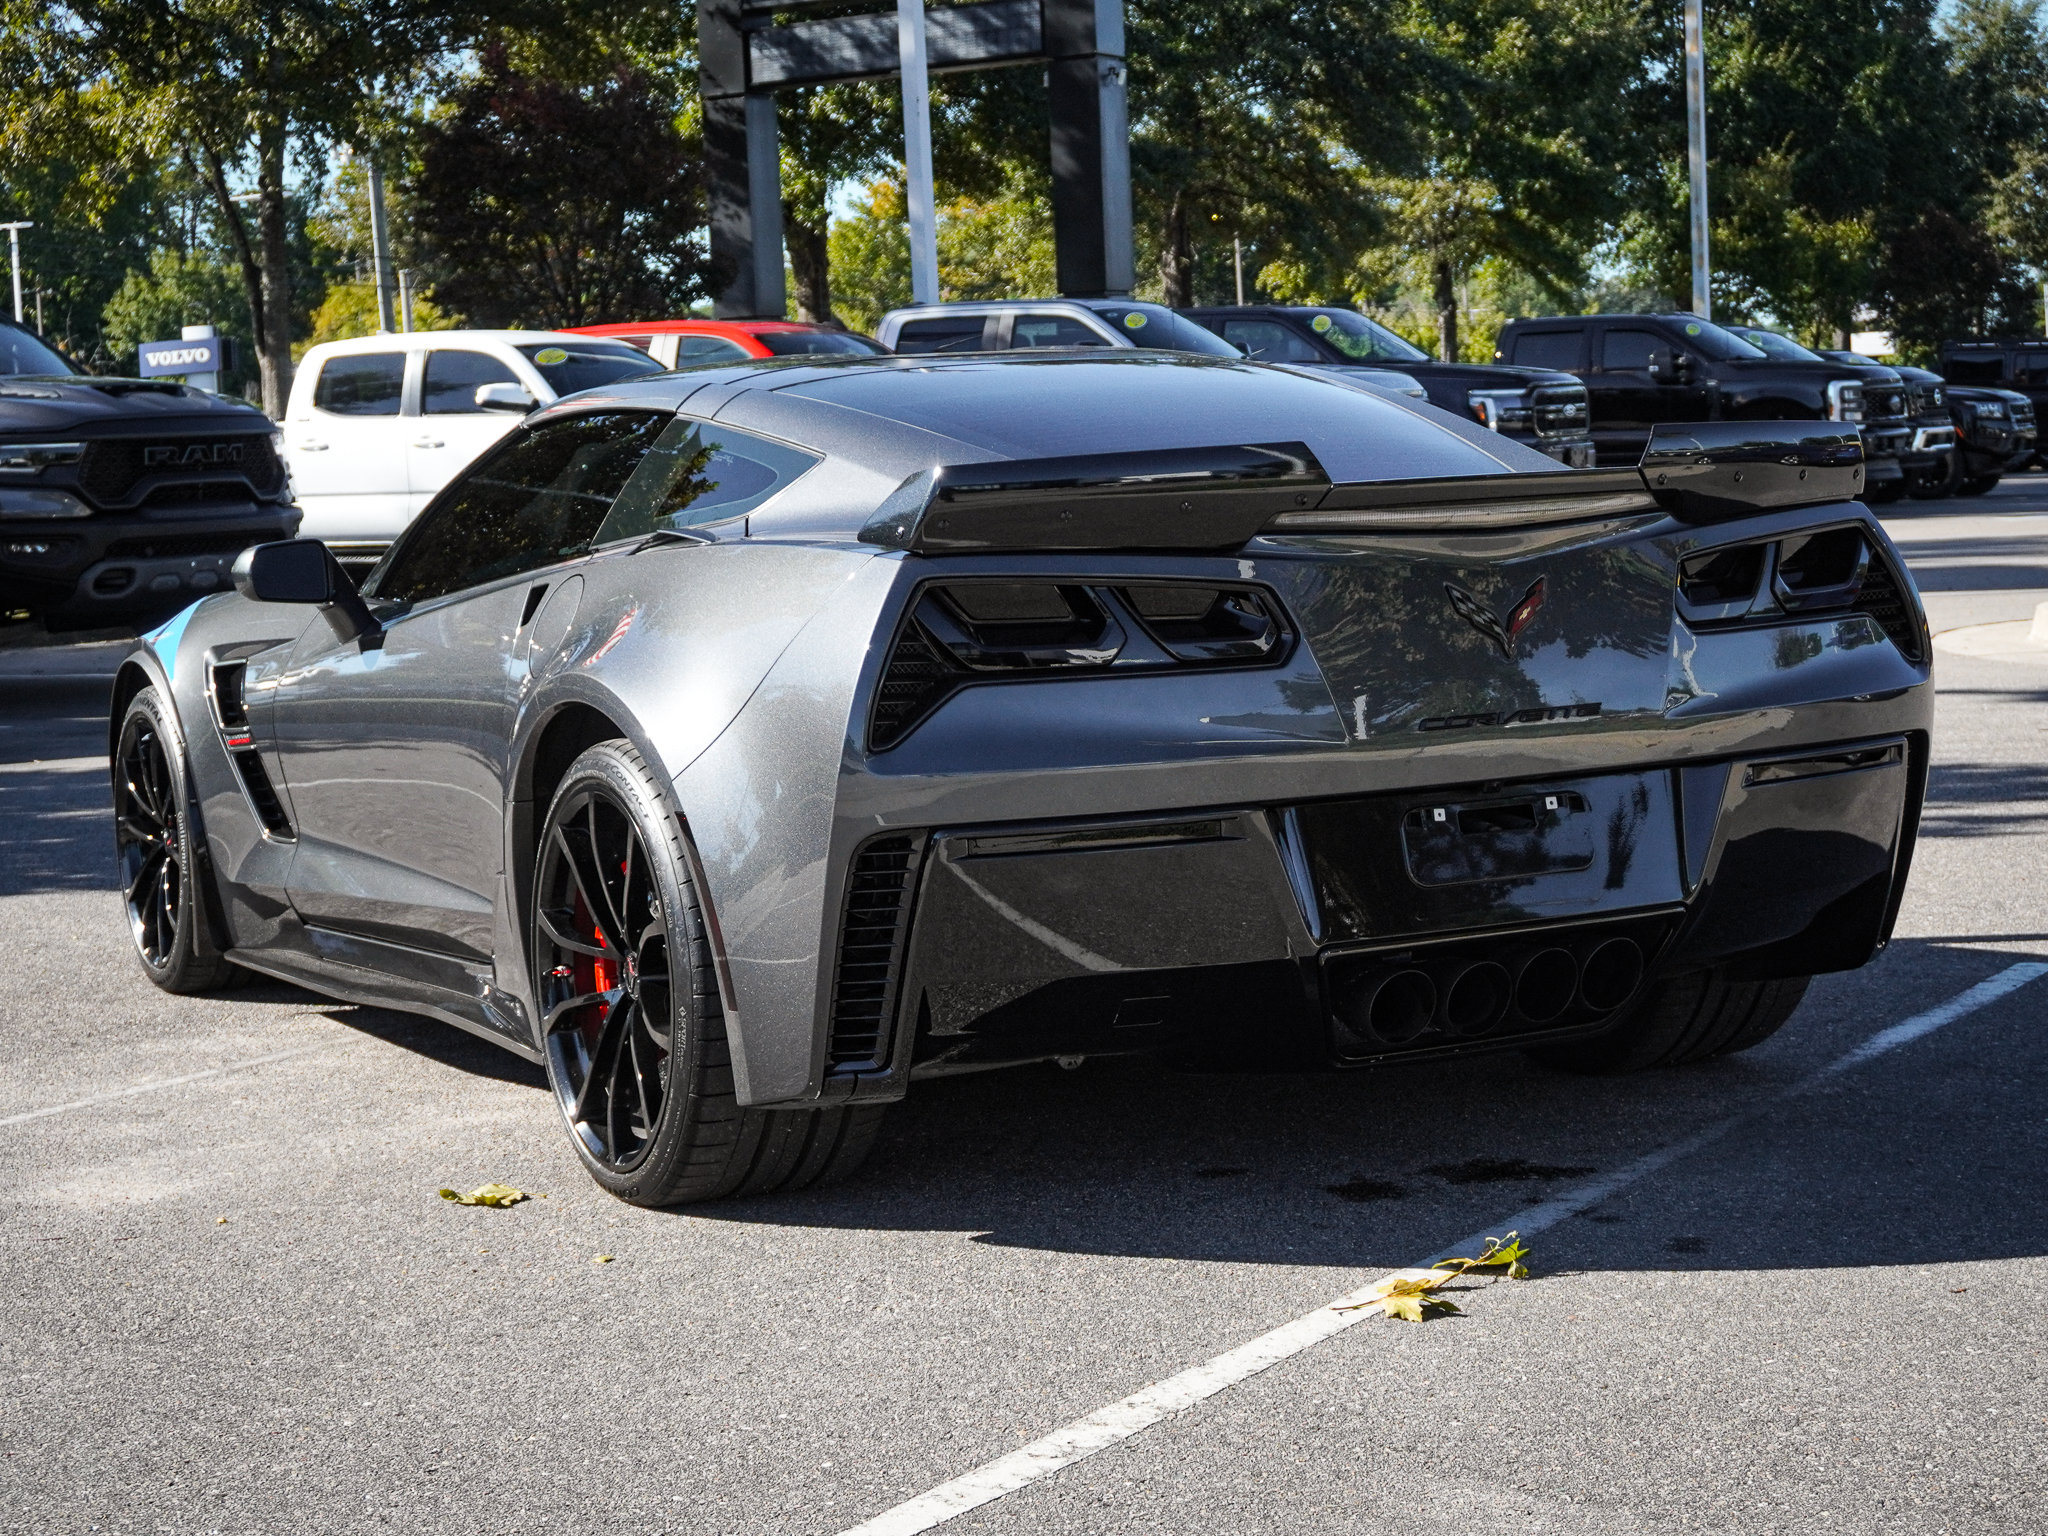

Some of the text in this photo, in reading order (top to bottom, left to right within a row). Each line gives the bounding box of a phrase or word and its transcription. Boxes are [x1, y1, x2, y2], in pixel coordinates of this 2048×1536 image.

[145, 347, 211, 367] VOLVO
[144, 443, 243, 466] RAM
[1418, 702, 1602, 732] CORVETTE
